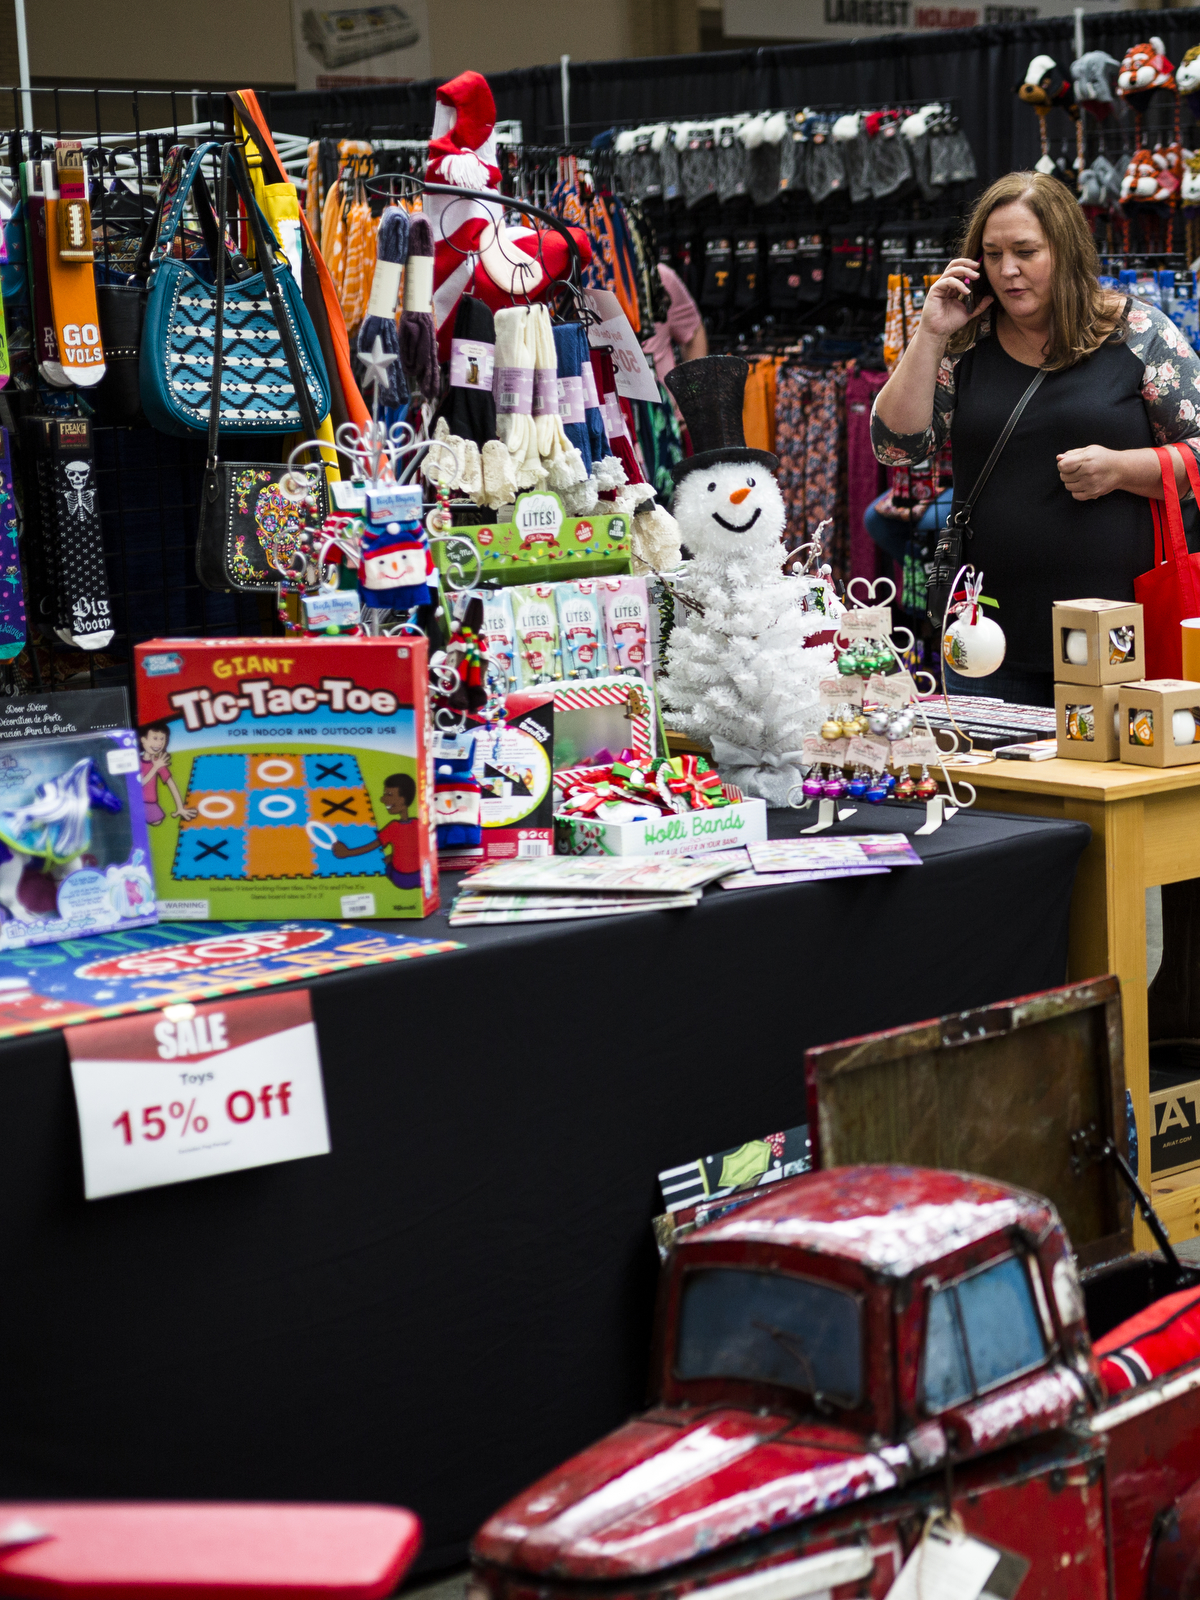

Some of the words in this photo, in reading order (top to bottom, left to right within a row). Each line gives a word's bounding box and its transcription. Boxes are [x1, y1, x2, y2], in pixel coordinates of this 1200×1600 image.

[63, 323, 99, 346] GO
[65, 347, 103, 364] VOLS
[522, 511, 556, 527] LITES!
[72, 597, 110, 617] Big
[614, 604, 642, 618] LITES!
[522, 612, 550, 627] LITES!
[566, 610, 592, 624] LITES!
[212, 656, 294, 679] GIANT
[5, 704, 25, 714] Door
[27, 702, 48, 713] Décor
[171, 679, 397, 730] Tic-Tac-Toe
[34, 714, 42, 723] de
[42, 712, 62, 723] Porte
[24, 726, 43, 737] Para
[43, 725, 51, 734] la
[52, 723, 77, 734] Puerta
[228, 729, 249, 738] FOR
[252, 728, 294, 737] INDOOR
[297, 728, 318, 736] AND
[321, 727, 373, 736] OUTDOOR
[376, 726, 397, 735] USE
[645, 820, 687, 845] Holli
[692, 810, 745, 836] Bands
[680, 845, 698, 854] CHEER
[706, 841, 721, 849] YOUR
[722, 837, 738, 845] BAND
[118, 935, 287, 972] STOP
[132, 937, 408, 993] HERE
[153, 1012, 229, 1060] SALE
[179, 1071, 214, 1085] Toys
[113, 1097, 209, 1146] 15%
[225, 1081, 292, 1124] Off
[1162, 1135, 1192, 1148] ARIAT.COM
